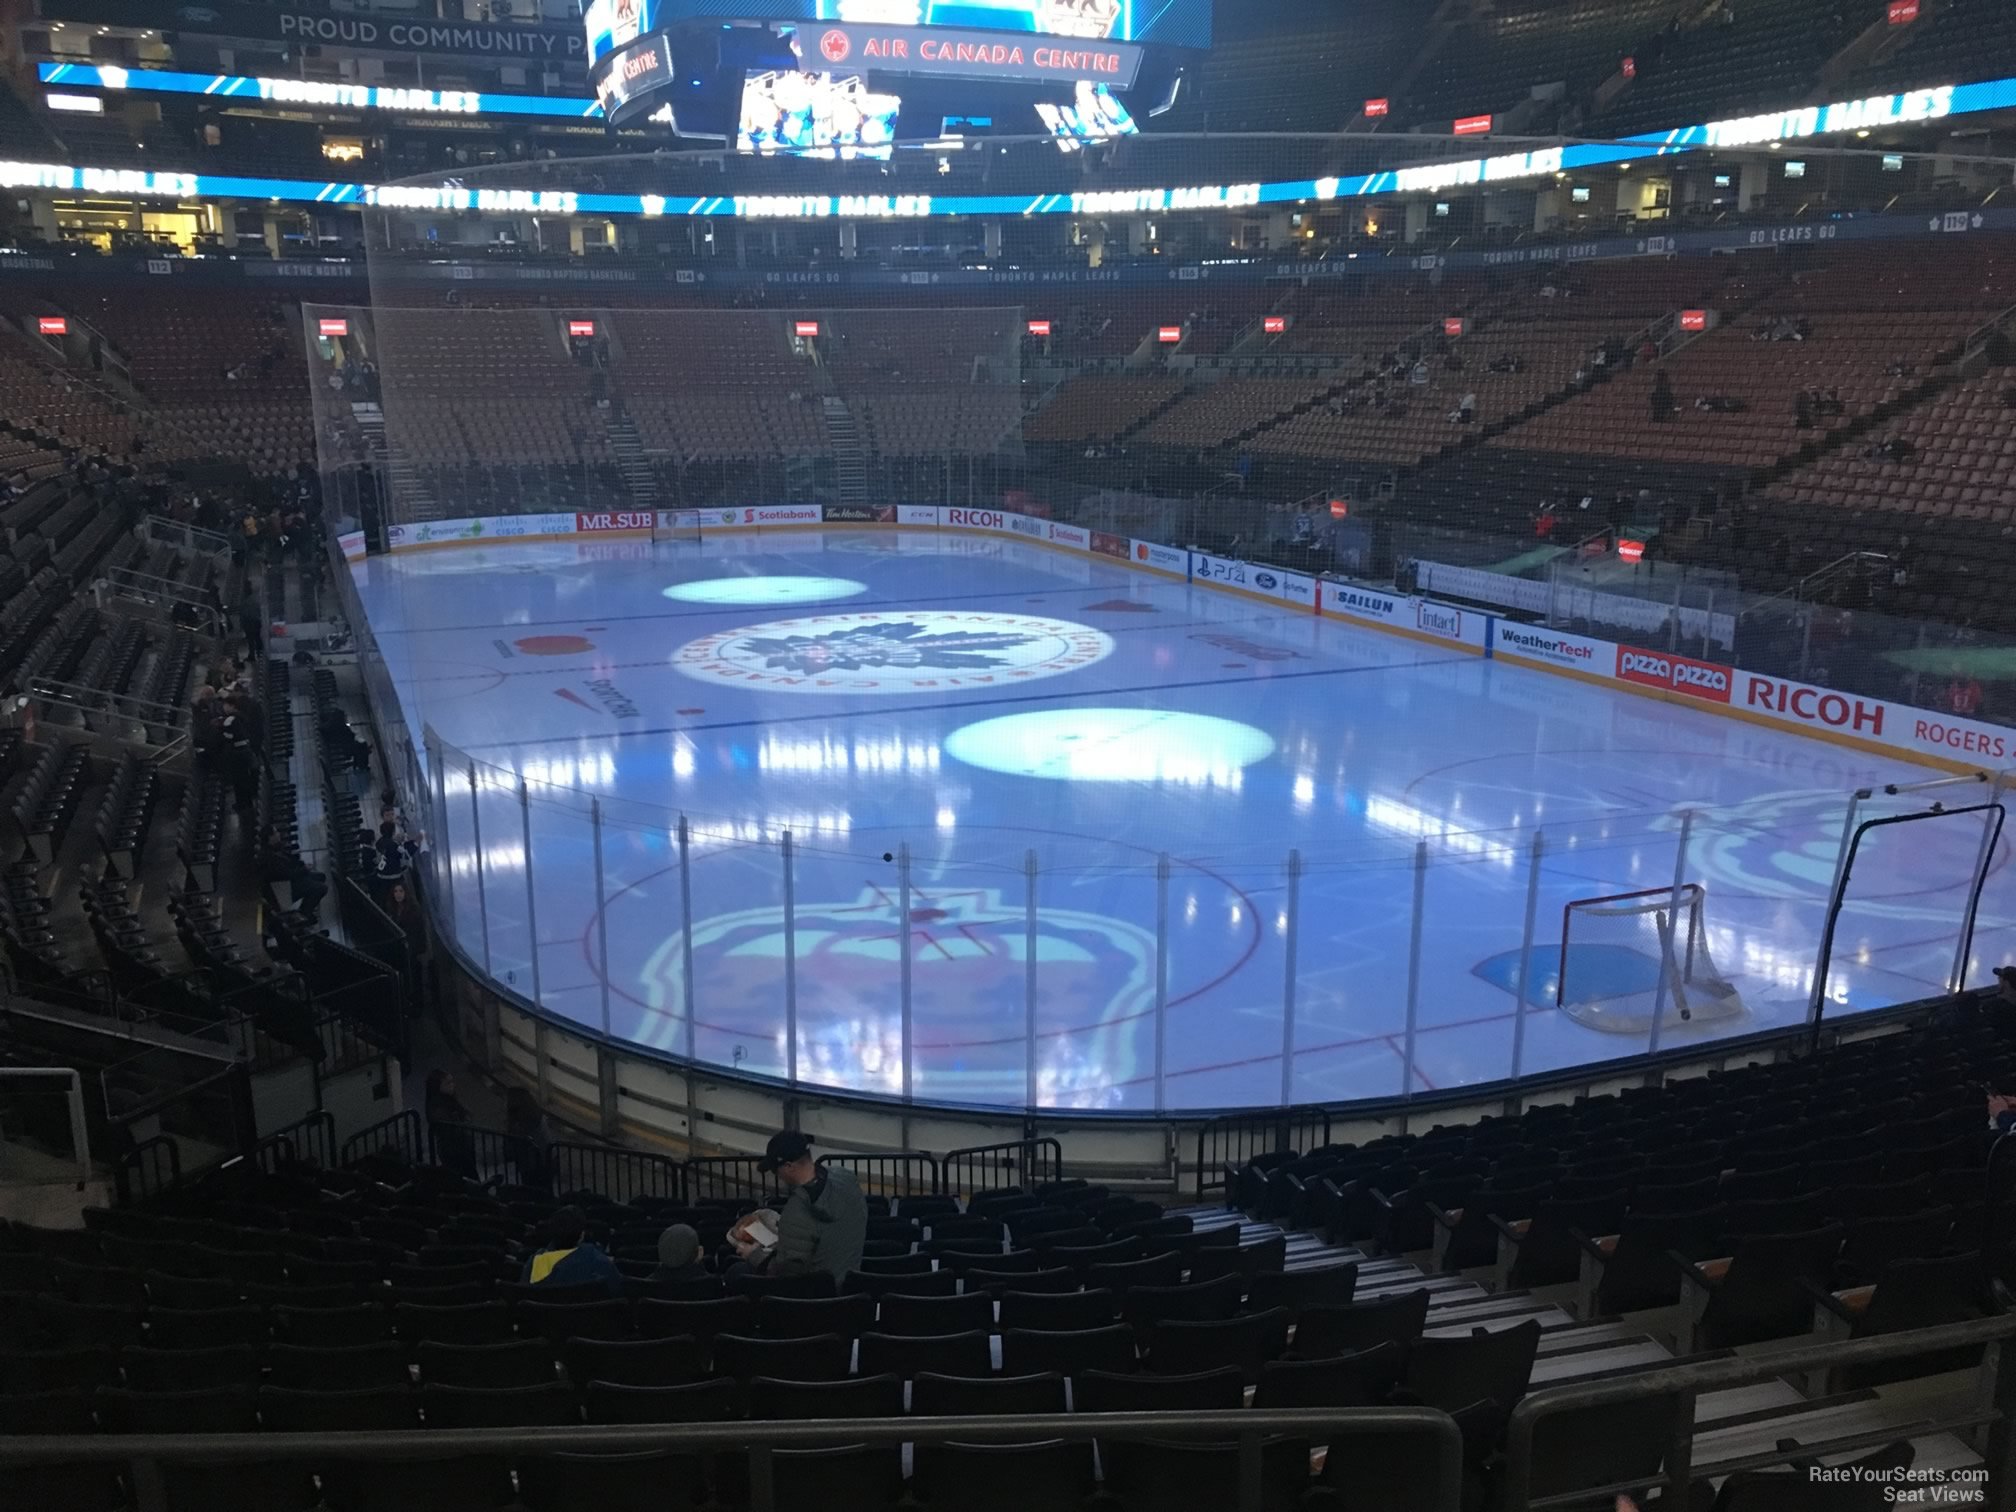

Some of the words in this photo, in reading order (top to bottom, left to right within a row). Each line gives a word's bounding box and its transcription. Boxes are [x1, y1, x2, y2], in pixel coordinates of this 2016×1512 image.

[280, 14, 377, 42] PROUD
[389, 24, 555, 53] COMMUNITY
[624, 50, 659, 80] CENTRE
[864, 38, 908, 58] AIR
[920, 40, 1024, 65] CANADA
[1034, 48, 1120, 73] CENTRE
[1706, 107, 1818, 147] TORONTO
[1825, 85, 1955, 133] MARLIES
[1945, 215, 1968, 230] 119
[1750, 230, 1765, 244] GO
[1771, 227, 1812, 242] LEAFS
[1819, 225, 1836, 239] GO
[2, 257, 55, 270] BASKETBALL
[1483, 250, 1525, 264] TORONTO
[1530, 247, 1561, 261] MAPLE
[1567, 245, 1598, 258] LEAFS
[150, 261, 169, 273] 112
[293, 265, 314, 276] THE
[316, 266, 352, 276] NORTH
[581, 511, 652, 530] MR.SUB
[759, 509, 817, 521] Scotiabank
[825, 507, 841, 519] Tim
[950, 508, 1003, 529] RICOH
[1214, 563, 1246, 584] PS4
[1338, 591, 1394, 614] SAILUN
[1423, 608, 1456, 633] intact
[1502, 628, 1592, 659] WeatherTech
[1621, 652, 1671, 678] pizza
[1673, 663, 1727, 691] pizza
[1747, 677, 1885, 736] RICOH
[1915, 720, 2005, 757] ROGERS
